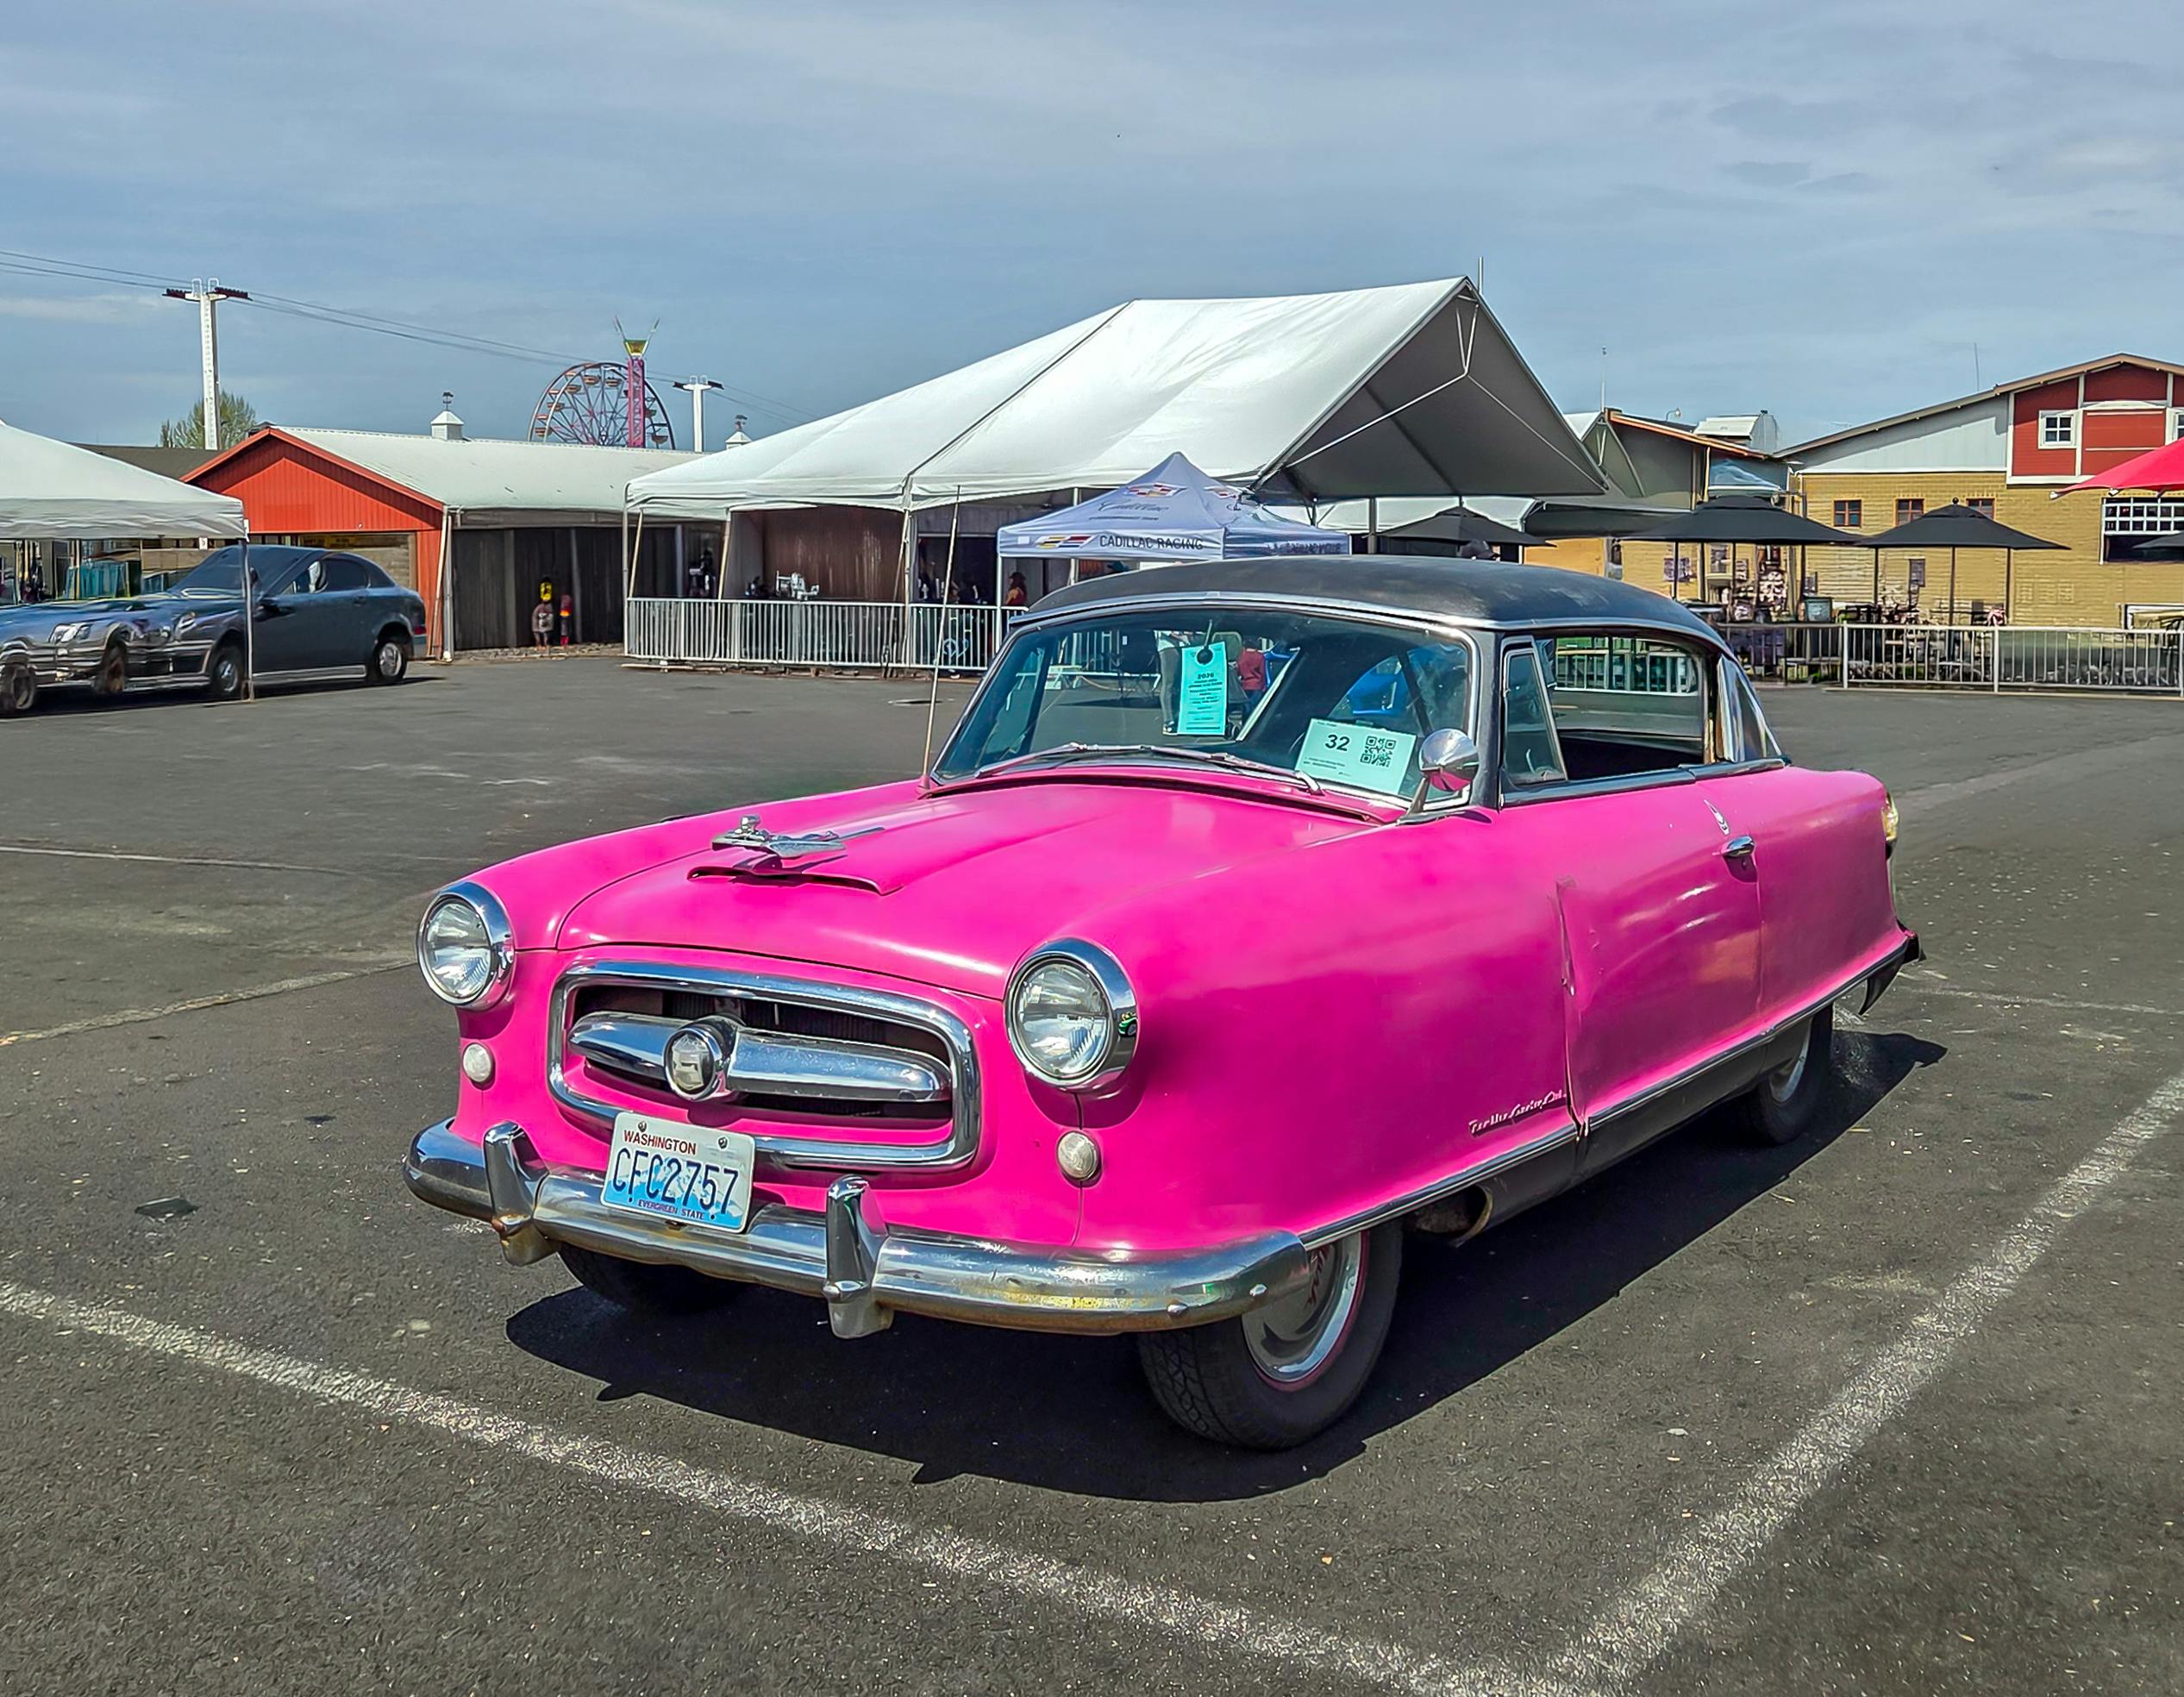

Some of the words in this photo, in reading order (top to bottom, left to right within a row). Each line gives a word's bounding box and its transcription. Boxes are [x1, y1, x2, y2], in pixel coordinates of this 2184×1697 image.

[1099, 535, 1154, 549] CADILLAC
[1157, 537, 1205, 550] RACING
[1324, 734, 1350, 752] 32
[623, 1130, 697, 1155] WASHINGTON
[612, 1148, 739, 1215] CFC2757
[638, 1199, 678, 1214] EVERGREEN
[681, 1209, 704, 1220] STATE
